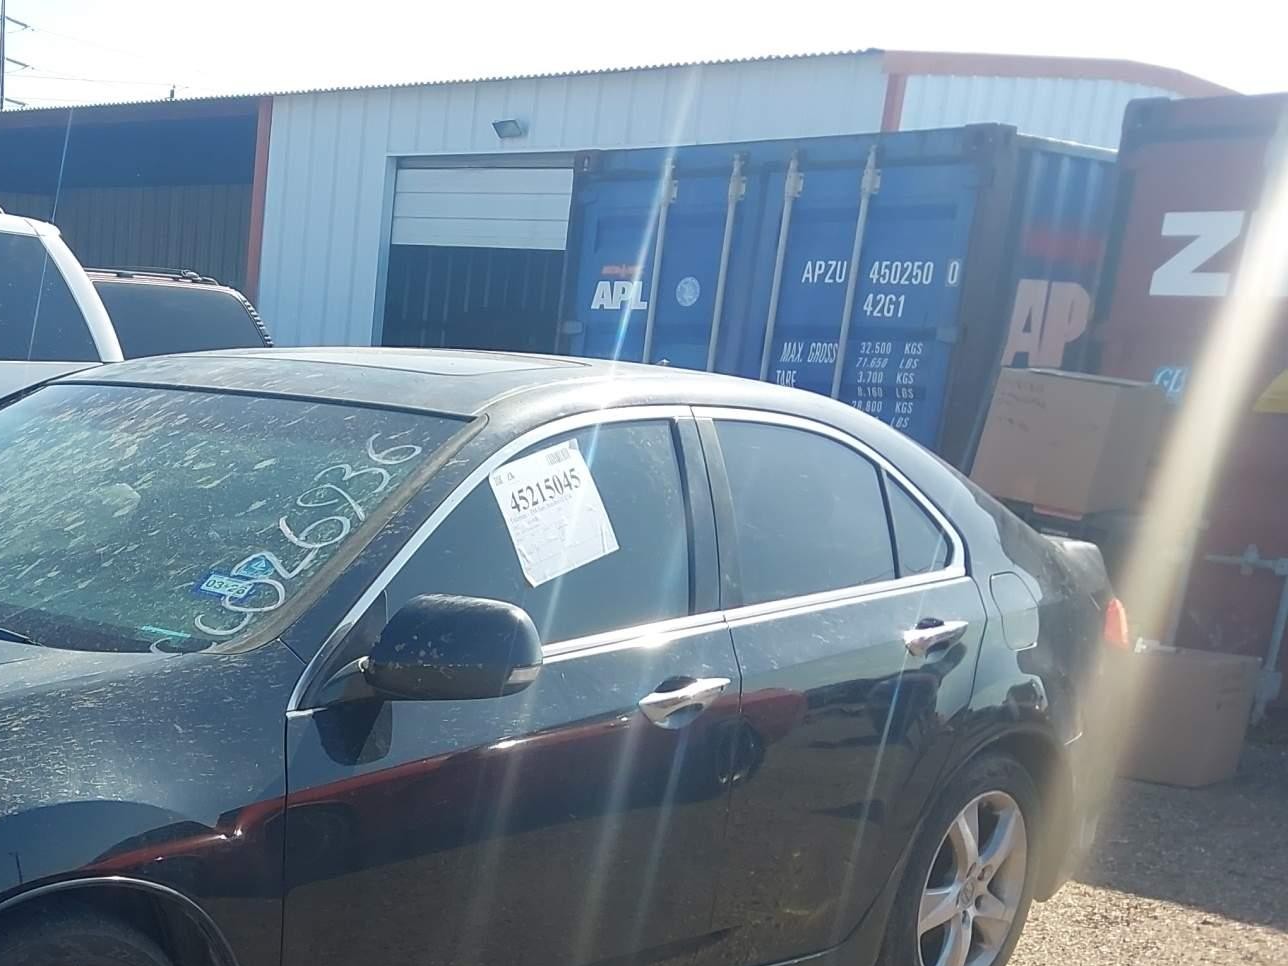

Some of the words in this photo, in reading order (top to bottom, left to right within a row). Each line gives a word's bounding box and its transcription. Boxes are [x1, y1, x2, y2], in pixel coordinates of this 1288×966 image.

[801, 260, 847, 283] APZU
[869, 261, 934, 285] 450250
[947, 261, 960, 285] 0
[591, 280, 648, 310] APL
[863, 294, 906, 317] 42G1
[780, 342, 804, 362] MAX.
[807, 342, 839, 363] GROSS
[860, 342, 892, 354] 32.500
[904, 342, 923, 355] KGS
[899, 358, 919, 369] LBS
[857, 371, 883, 384] 3.700
[896, 372, 914, 385] KGS
[895, 387, 914, 399] LBS
[894, 400, 913, 414] KGS
[510, 467, 581, 513] 45215045
